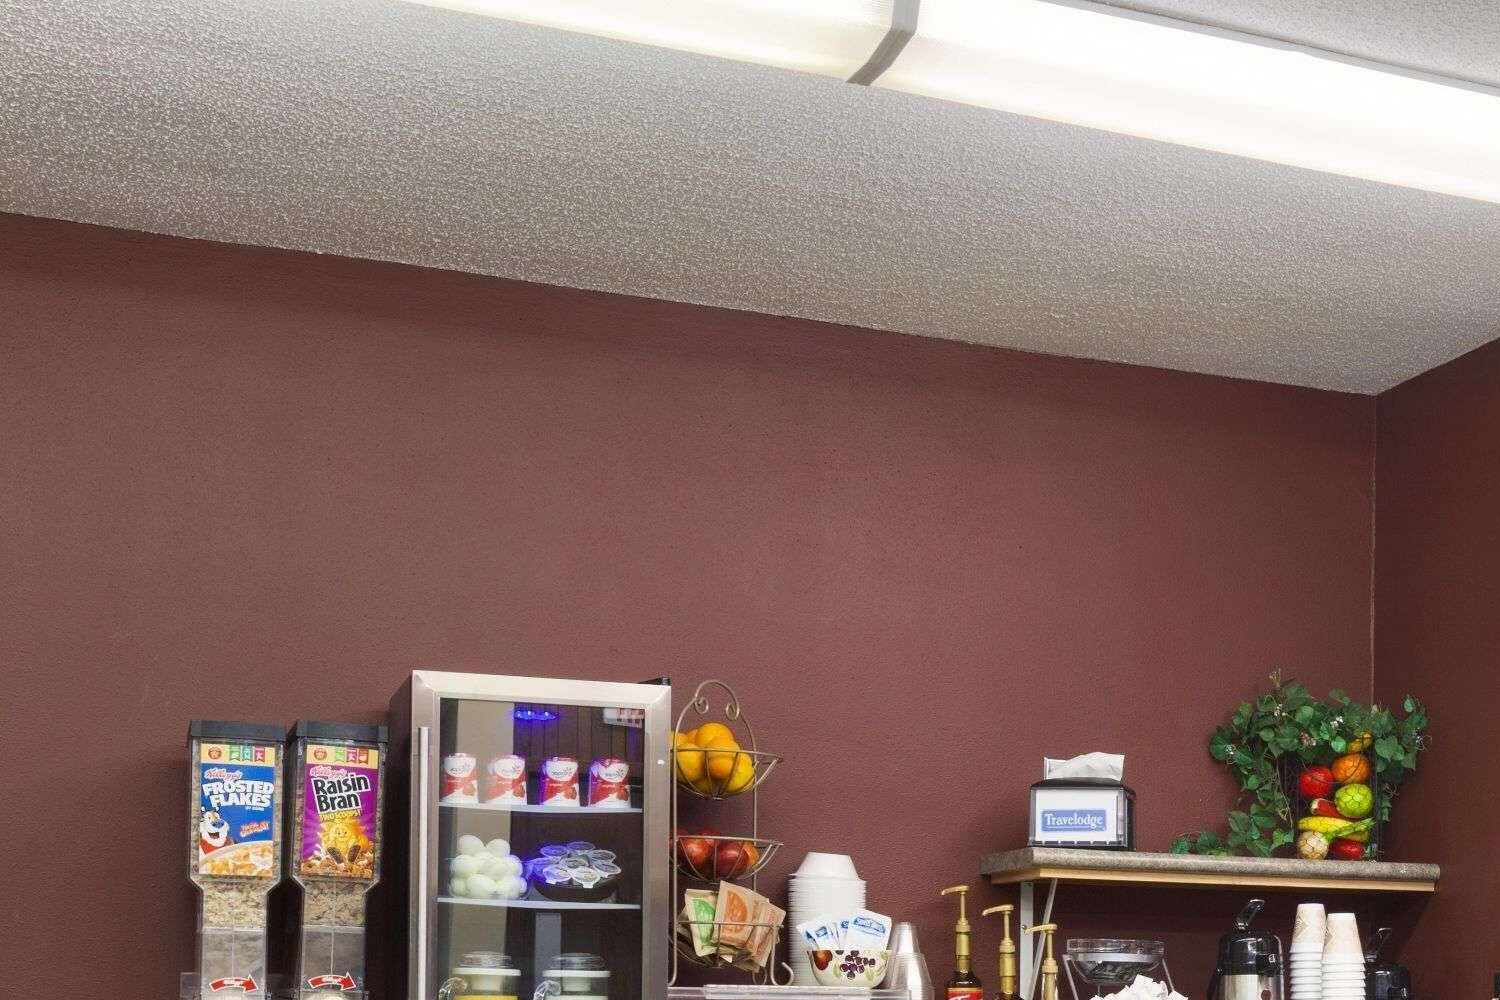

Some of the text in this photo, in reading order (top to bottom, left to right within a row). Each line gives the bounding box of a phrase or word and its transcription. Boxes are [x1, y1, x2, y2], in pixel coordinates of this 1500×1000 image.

[202, 780, 274, 797] FROSTED
[313, 775, 370, 796] Raisin
[209, 792, 272, 808] FLAKES
[316, 793, 360, 812] Bran
[1044, 812, 1104, 829] Travelodge
